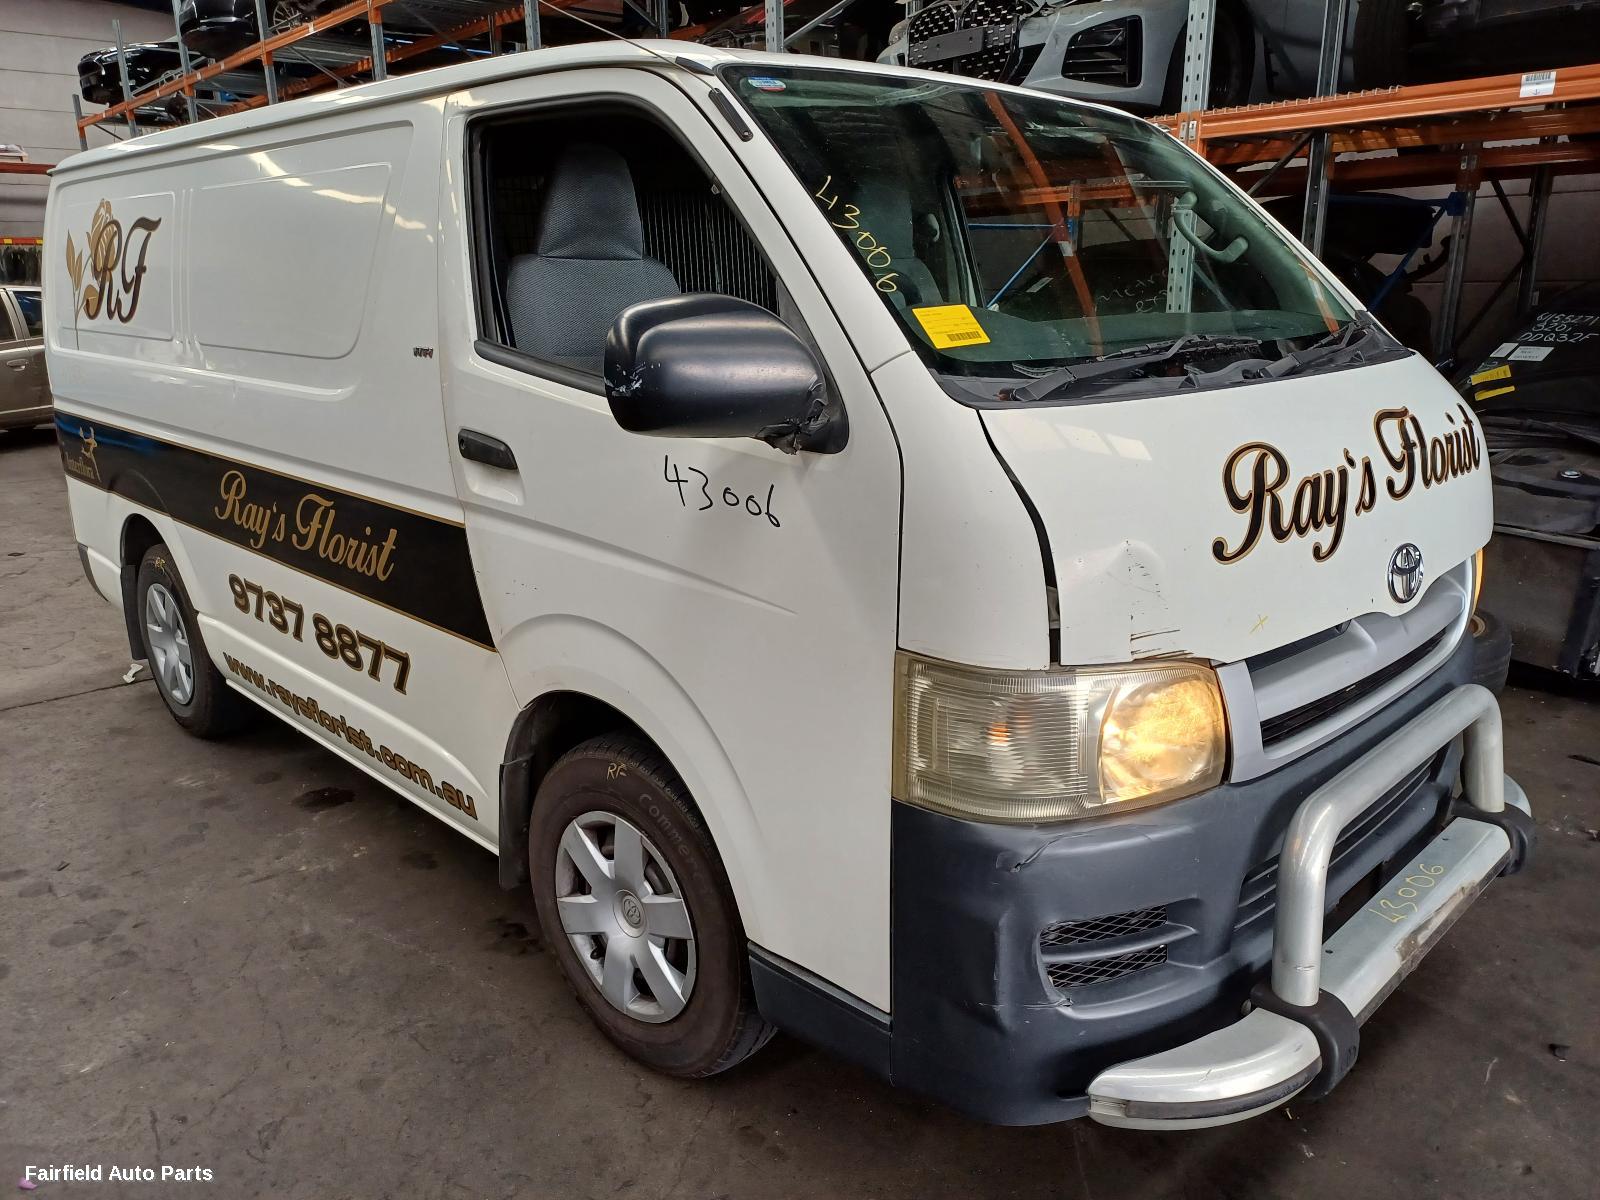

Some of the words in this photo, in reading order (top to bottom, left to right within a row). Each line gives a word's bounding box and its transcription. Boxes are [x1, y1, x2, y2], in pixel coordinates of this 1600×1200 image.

[815, 175, 900, 292] 43006
[214, 469, 286, 550] Ray's
[291, 492, 398, 582] Florist
[664, 454, 781, 528] 43006
[1212, 441, 1376, 563] Ray's
[1373, 402, 1481, 500] Florist
[228, 573, 305, 643] 9737
[312, 612, 411, 695] 8877
[222, 651, 479, 822] www.raysflorist.com.au
